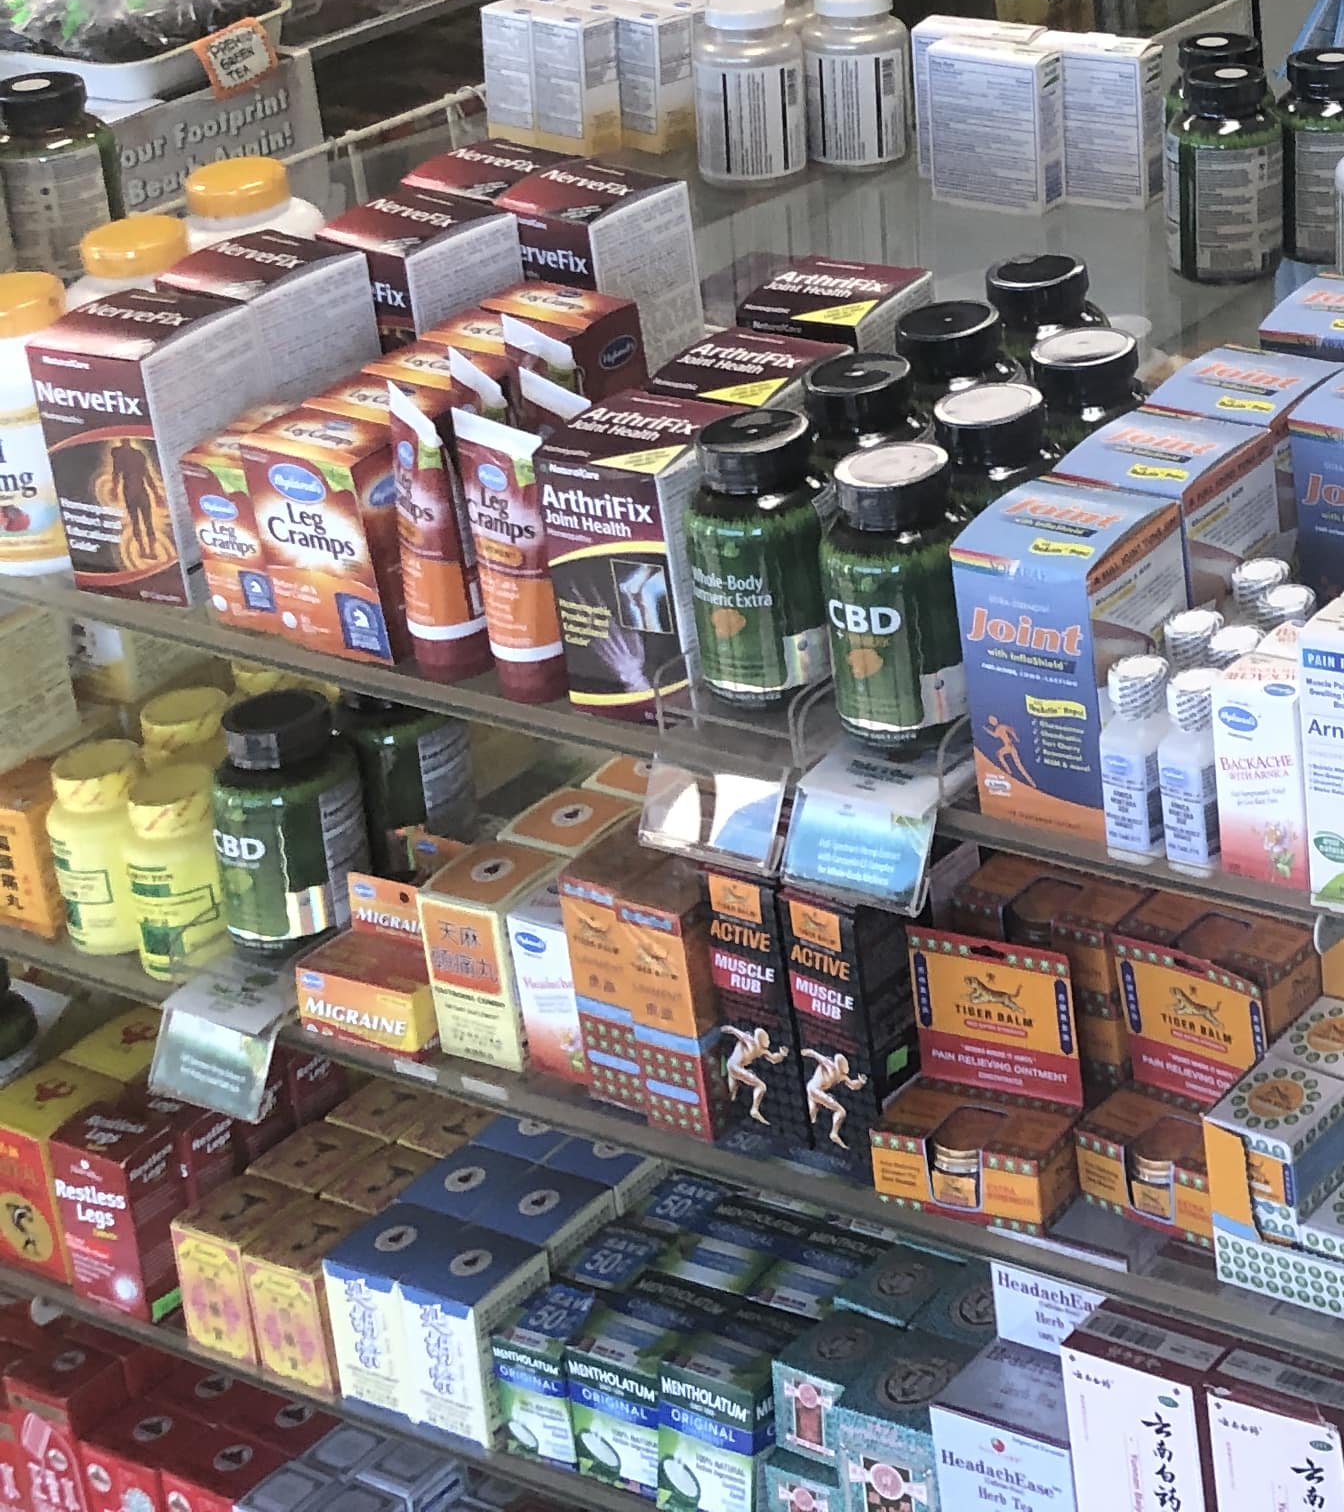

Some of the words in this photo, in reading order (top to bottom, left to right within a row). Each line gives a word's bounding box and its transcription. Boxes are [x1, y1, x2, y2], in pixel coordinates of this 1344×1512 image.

[175, 88, 288, 148] Footprint
[448, 148, 541, 175] NerveFix
[540, 169, 634, 198] NerveFix
[368, 198, 458, 230] NerveFix
[210, 240, 304, 270] NerveFix
[776, 269, 887, 294] ArthriFix
[81, 301, 190, 327] NerveFix
[693, 342, 801, 370] ArthriFix
[34, 381, 143, 416] NerveFix
[584, 406, 700, 437] ArthriFix
[286, 503, 323, 536] Leg
[480, 489, 509, 519] Leg
[543, 484, 653, 524] ArthriFix
[211, 521, 236, 541] Leg
[469, 499, 536, 543] Cramps
[545, 510, 578, 532] Joint
[582, 515, 632, 539] Health
[199, 529, 257, 556] Cramps
[268, 517, 356, 559] Cramps
[735, 591, 773, 609] Extra
[828, 599, 901, 636] CBD
[967, 607, 1084, 657] Joint
[1307, 653, 1335, 668] PAIN
[212, 829, 266, 861] CBD
[710, 920, 770, 953] ACTIVE
[715, 953, 775, 983] MUSCLE
[791, 945, 850, 981] ACTIVE
[731, 972, 761, 994] RUB
[795, 978, 854, 1011] MUSCLE
[305, 997, 407, 1036] MIGRAINE
[811, 999, 842, 1020] RUB
[955, 1004, 992, 1020] TIGER
[997, 1012, 1033, 1027] BALM
[932, 1049, 955, 1062] PAIN
[958, 1054, 1012, 1073] RELIEVING
[1014, 1065, 1067, 1083] OINTMENT
[56, 1179, 127, 1211] Restless
[75, 1205, 115, 1230] Legs
[1035, 1311, 1065, 1330] Herb
[494, 1347, 558, 1376] MENTHOLATUM
[499, 1365, 558, 1393] ORIGINAL
[568, 1359, 655, 1402] MENTHOLATUM
[582, 1387, 648, 1420] ORIGINAL
[661, 1376, 747, 1423] MENTHOLATUM
[671, 1408, 736, 1443] ORIGINAL
[940, 1449, 1055, 1496] HeadachEase
[978, 1485, 1006, 1503] Herb
[1011, 1495, 1034, 1512] Tea
